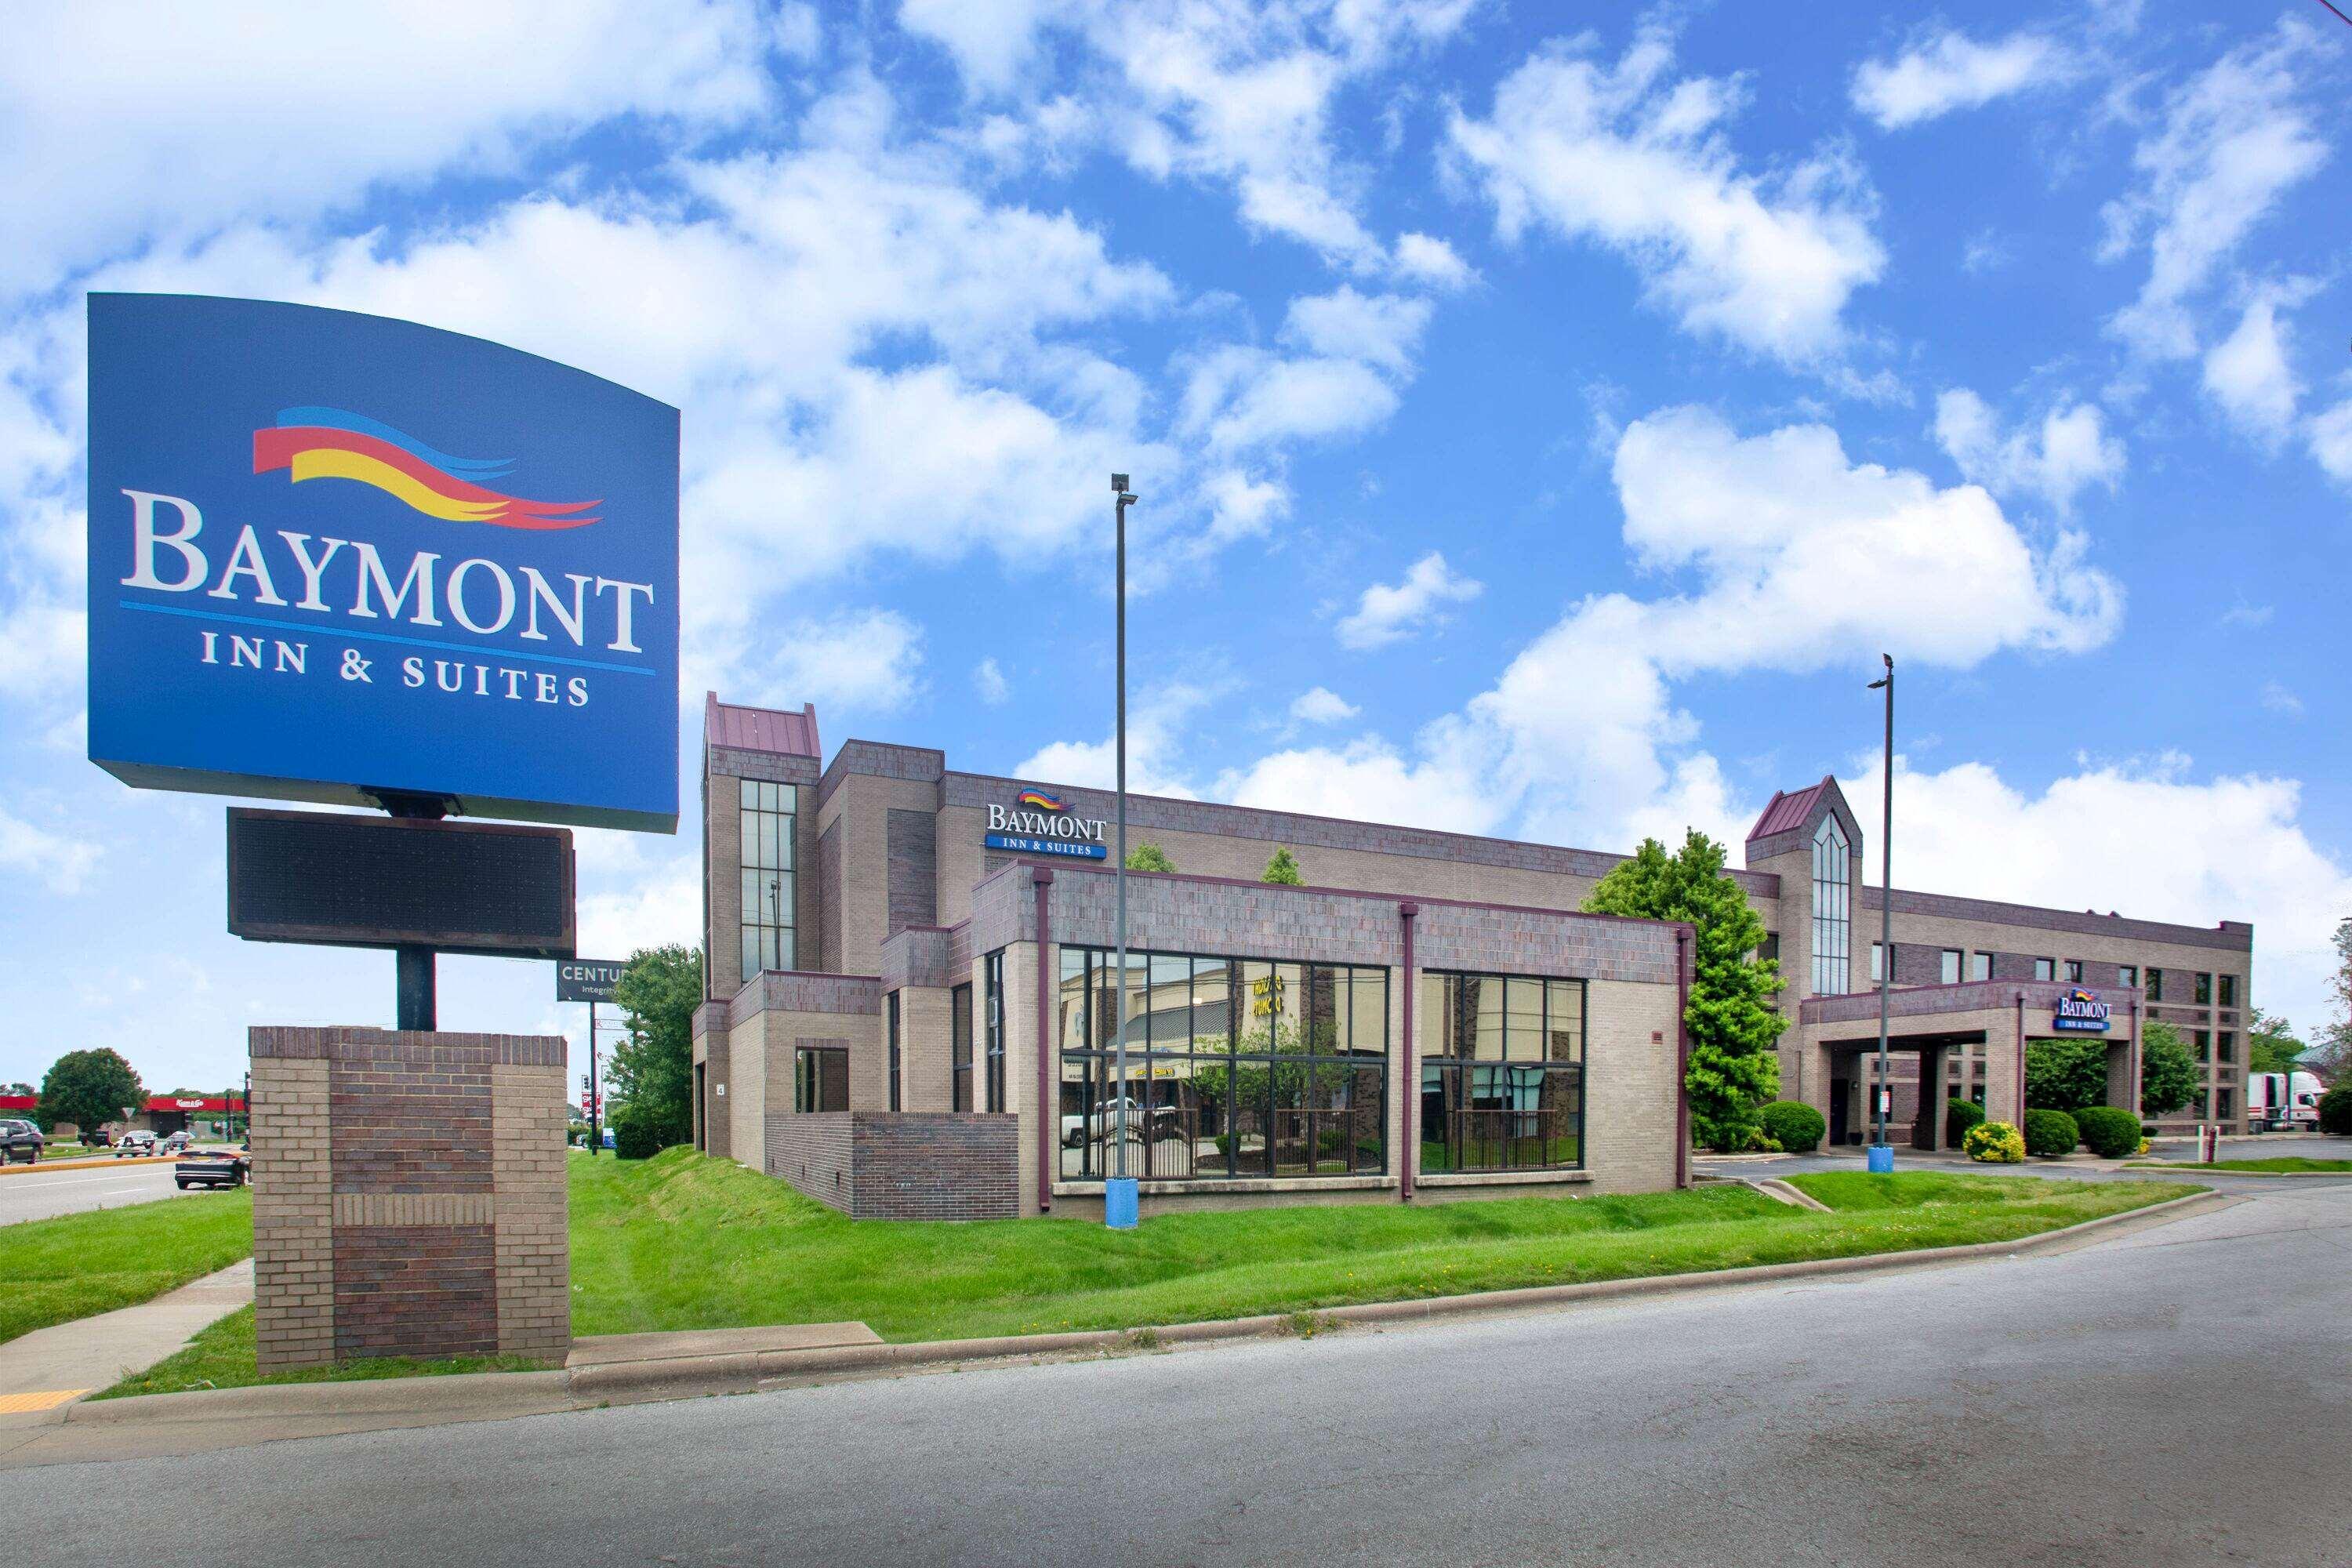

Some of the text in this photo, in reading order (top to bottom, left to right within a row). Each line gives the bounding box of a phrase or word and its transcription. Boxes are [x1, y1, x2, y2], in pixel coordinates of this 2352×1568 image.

[121, 488, 654, 654] BAYMONT
[201, 631, 590, 706] INN & SUITES
[987, 804, 1106, 840] BAYMONT
[1003, 837, 1091, 855] INN & SUITES
[2060, 997, 2112, 1018] BAYMONT
